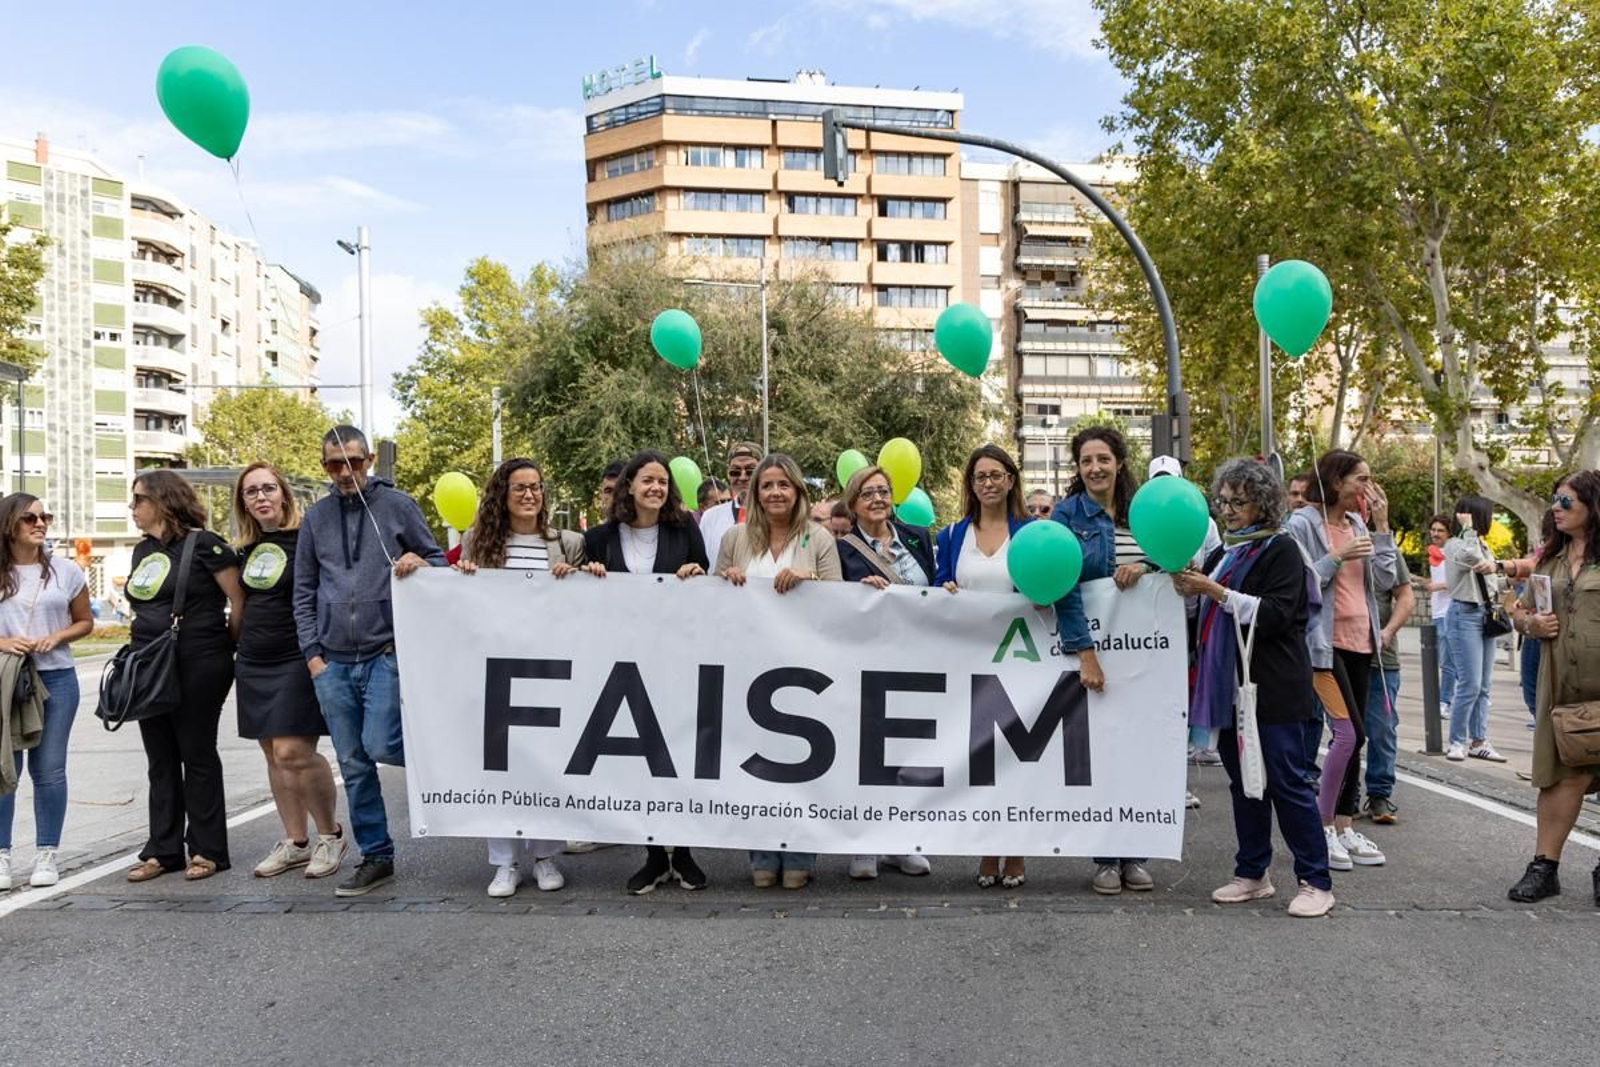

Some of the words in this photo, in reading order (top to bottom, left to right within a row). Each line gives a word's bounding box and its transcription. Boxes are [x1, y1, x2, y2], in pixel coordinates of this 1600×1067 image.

[583, 53, 662, 100] HOTEL
[1092, 629, 1170, 652] ndalucía
[483, 657, 1092, 787] FAISEM
[421, 788, 497, 805] undación
[501, 789, 561, 808] Pública
[565, 794, 642, 812] Andaluza
[646, 800, 683, 817] para
[688, 798, 704, 814] la
[708, 799, 802, 821] Integración
[808, 804, 859, 821] Social
[863, 806, 884, 822] de
[888, 807, 968, 823] Personas
[972, 809, 1002, 822] con
[1007, 806, 1113, 823] Enfermedad
[1119, 807, 1178, 825] Mental
